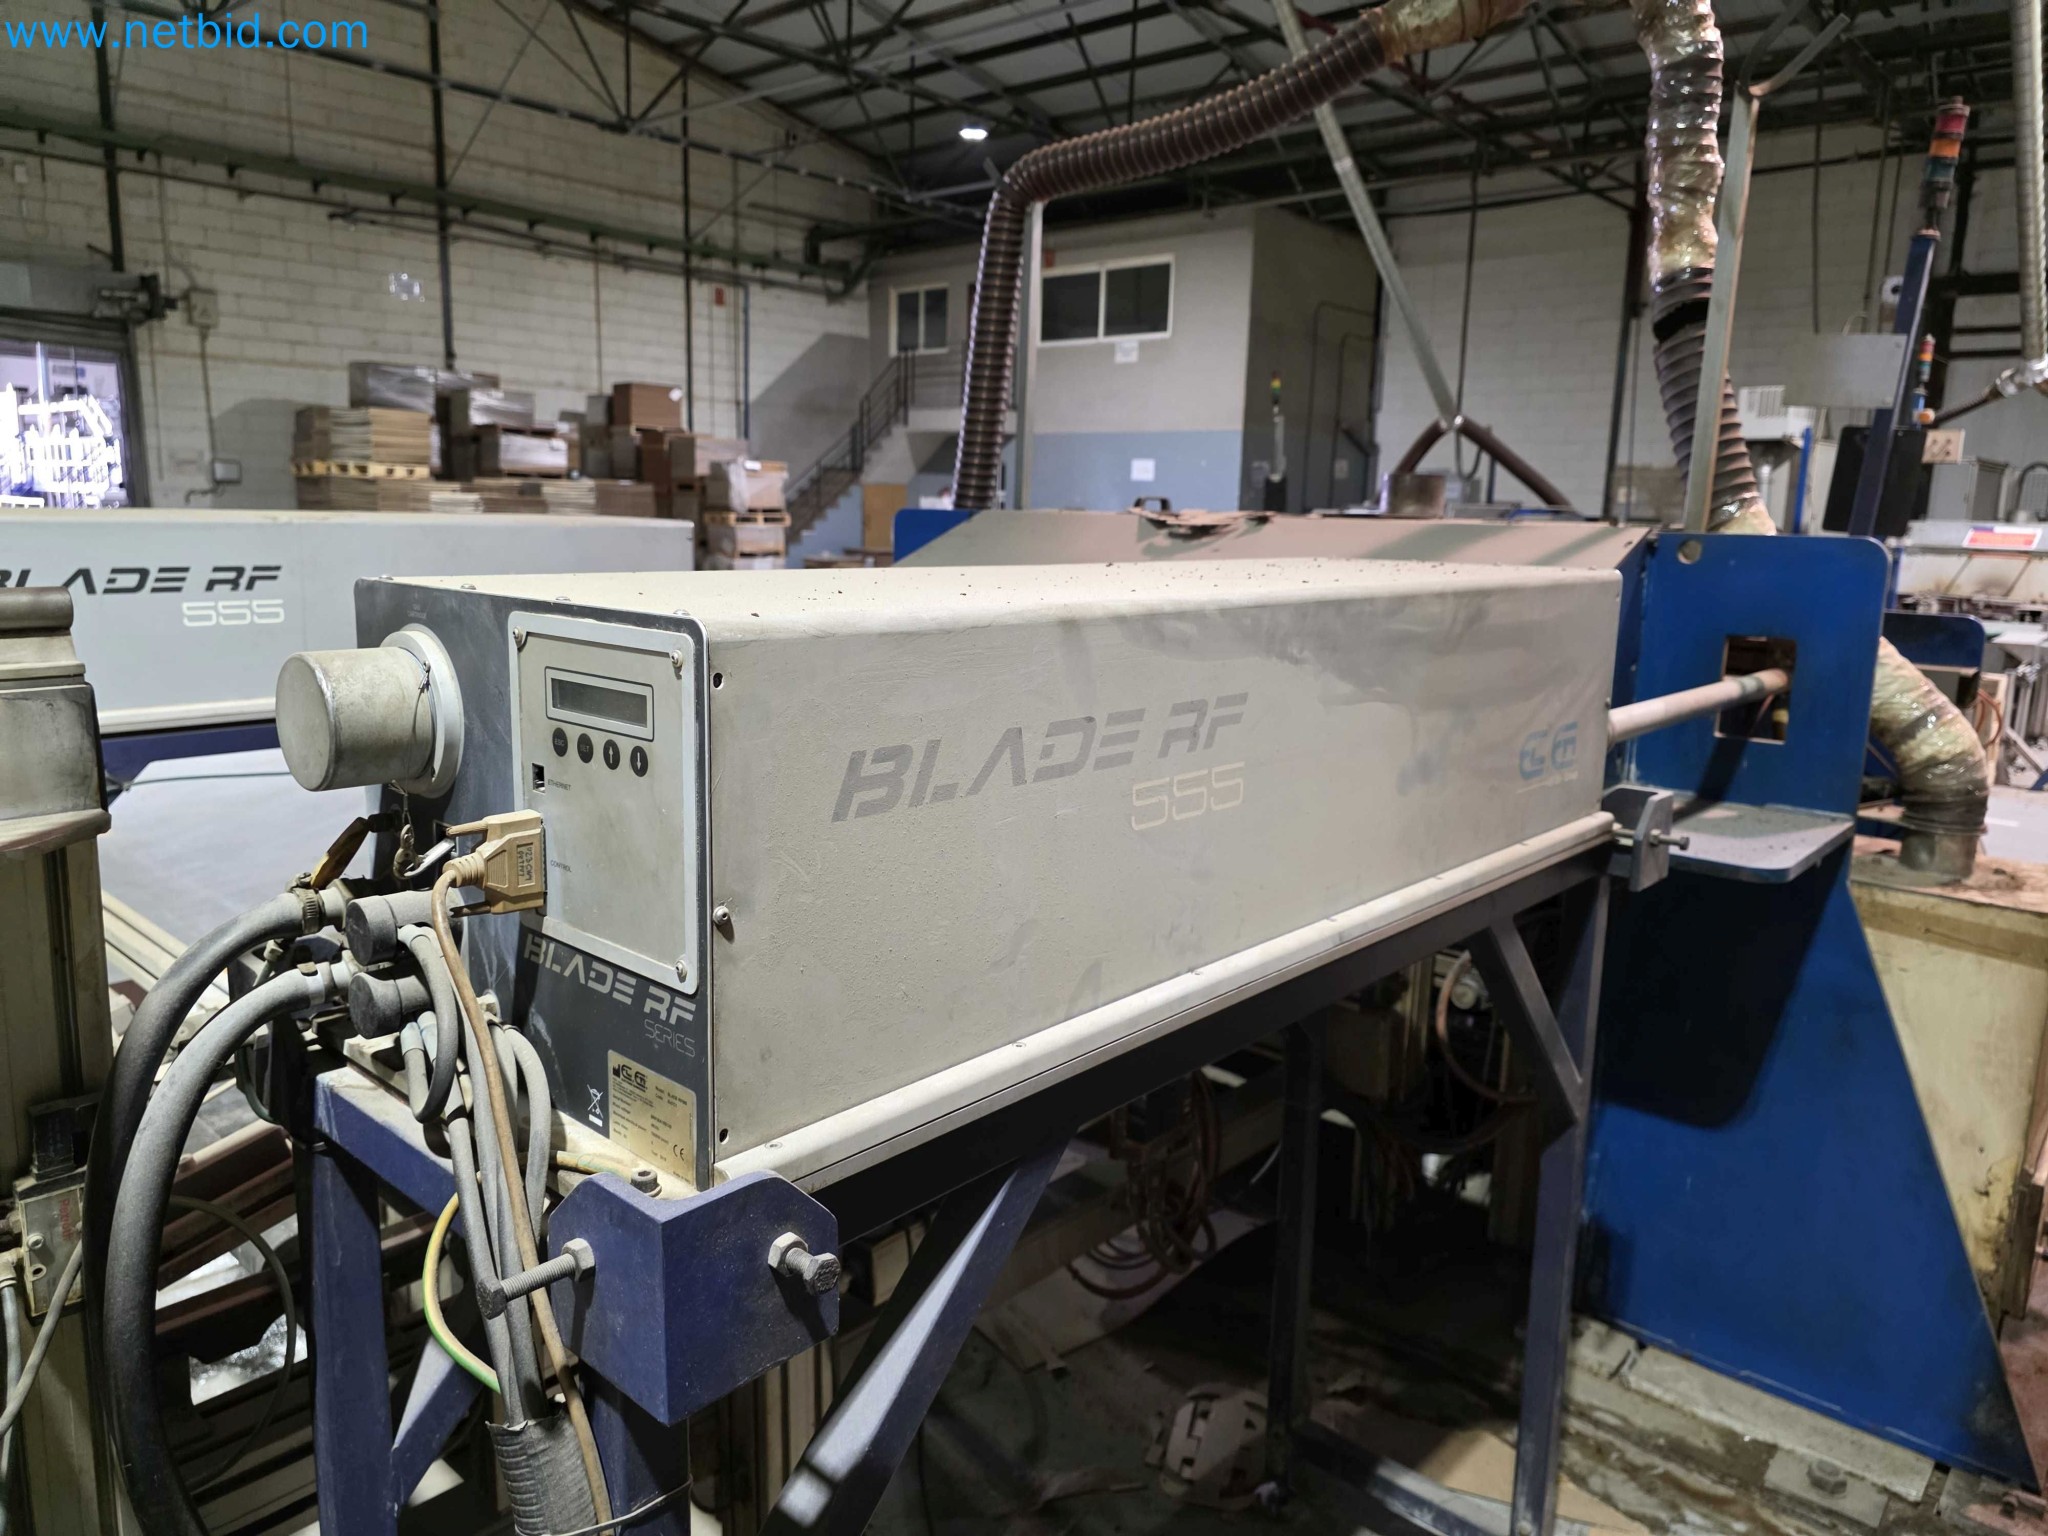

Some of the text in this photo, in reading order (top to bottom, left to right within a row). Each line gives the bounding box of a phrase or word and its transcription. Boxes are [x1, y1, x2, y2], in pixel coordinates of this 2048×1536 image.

[0, 564, 282, 595] LADE RF
[181, 598, 285, 628] 555
[830, 691, 1250, 823] BLADE RF
[547, 778, 571, 792] ETHERNET
[1130, 760, 1246, 832] 555
[550, 859, 572, 873] CONTROL
[523, 932, 697, 1026] BLADE RF
[643, 1018, 696, 1059] SERIES
